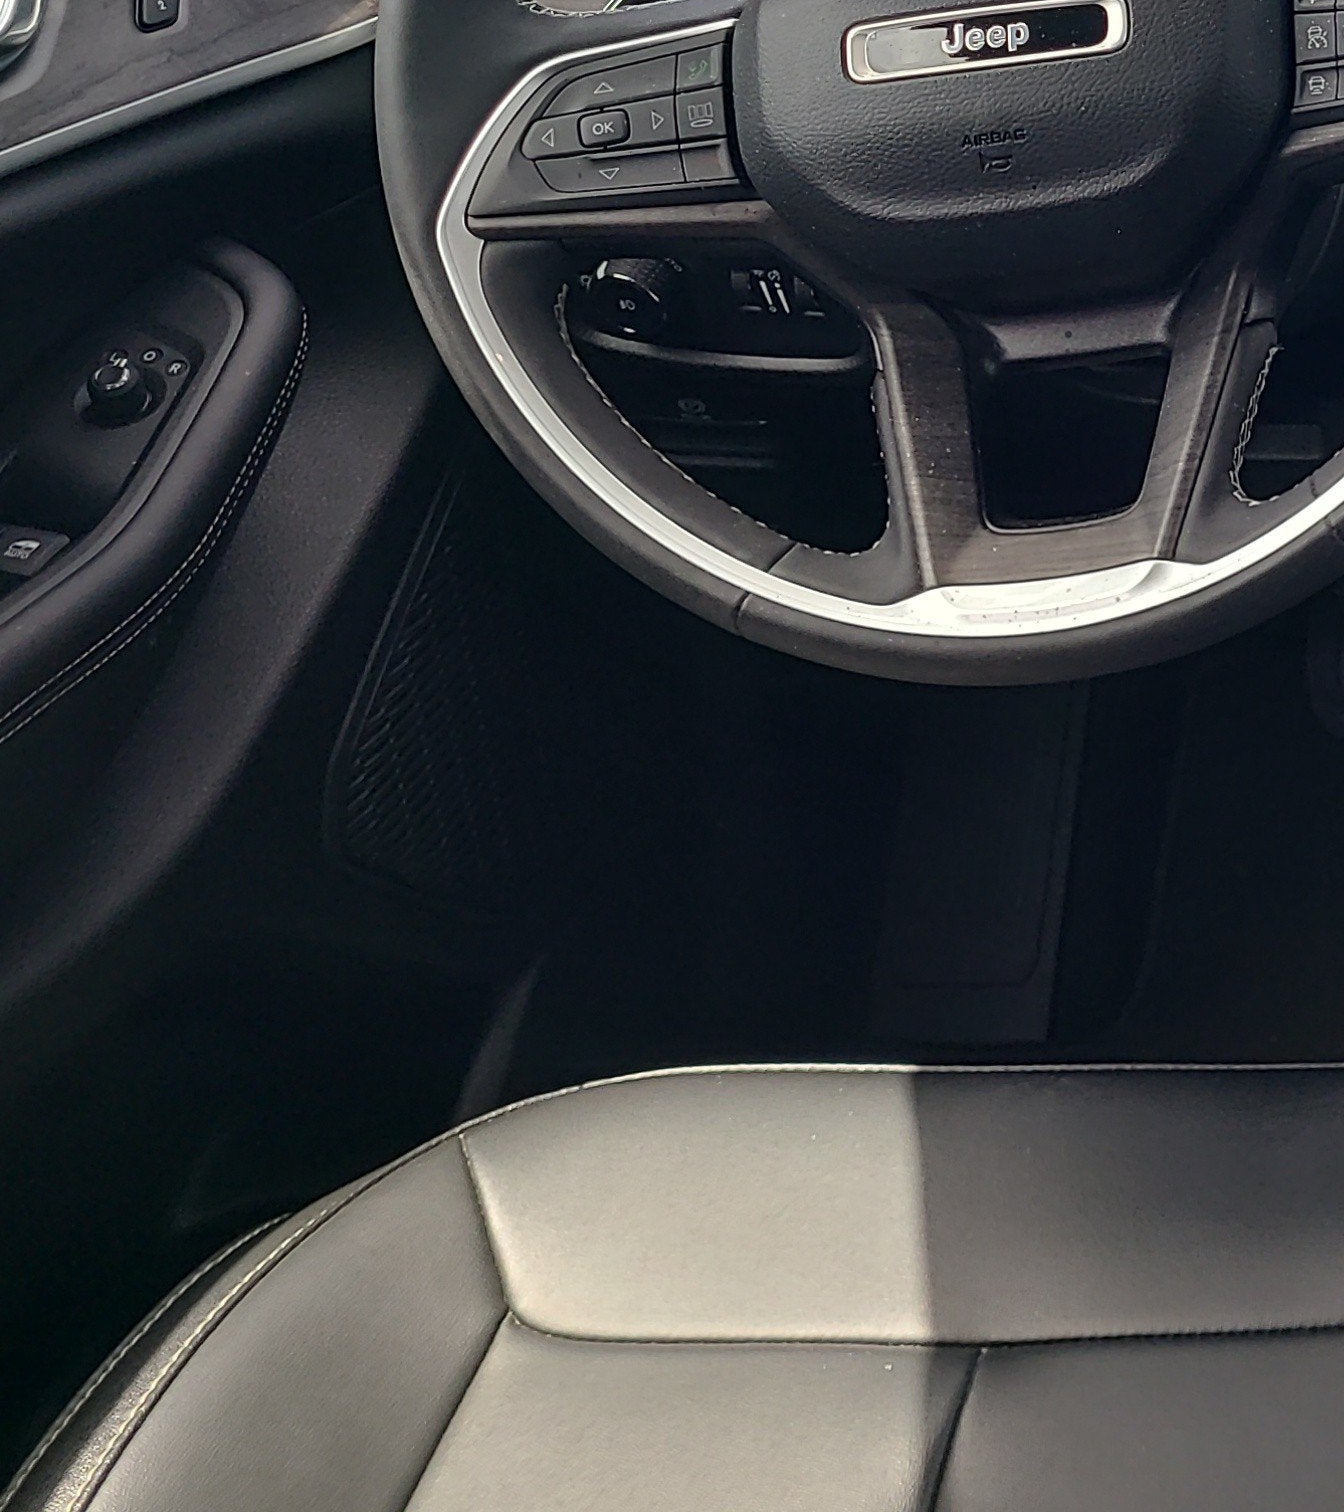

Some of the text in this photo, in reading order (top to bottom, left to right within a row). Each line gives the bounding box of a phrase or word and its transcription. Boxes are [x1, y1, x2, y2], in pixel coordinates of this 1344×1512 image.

[157, 0, 168, 11] 2
[940, 21, 1030, 55] Jeep
[592, 121, 615, 135] OK
[961, 128, 1028, 150] AIRBAG
[168, 362, 182, 374] R
